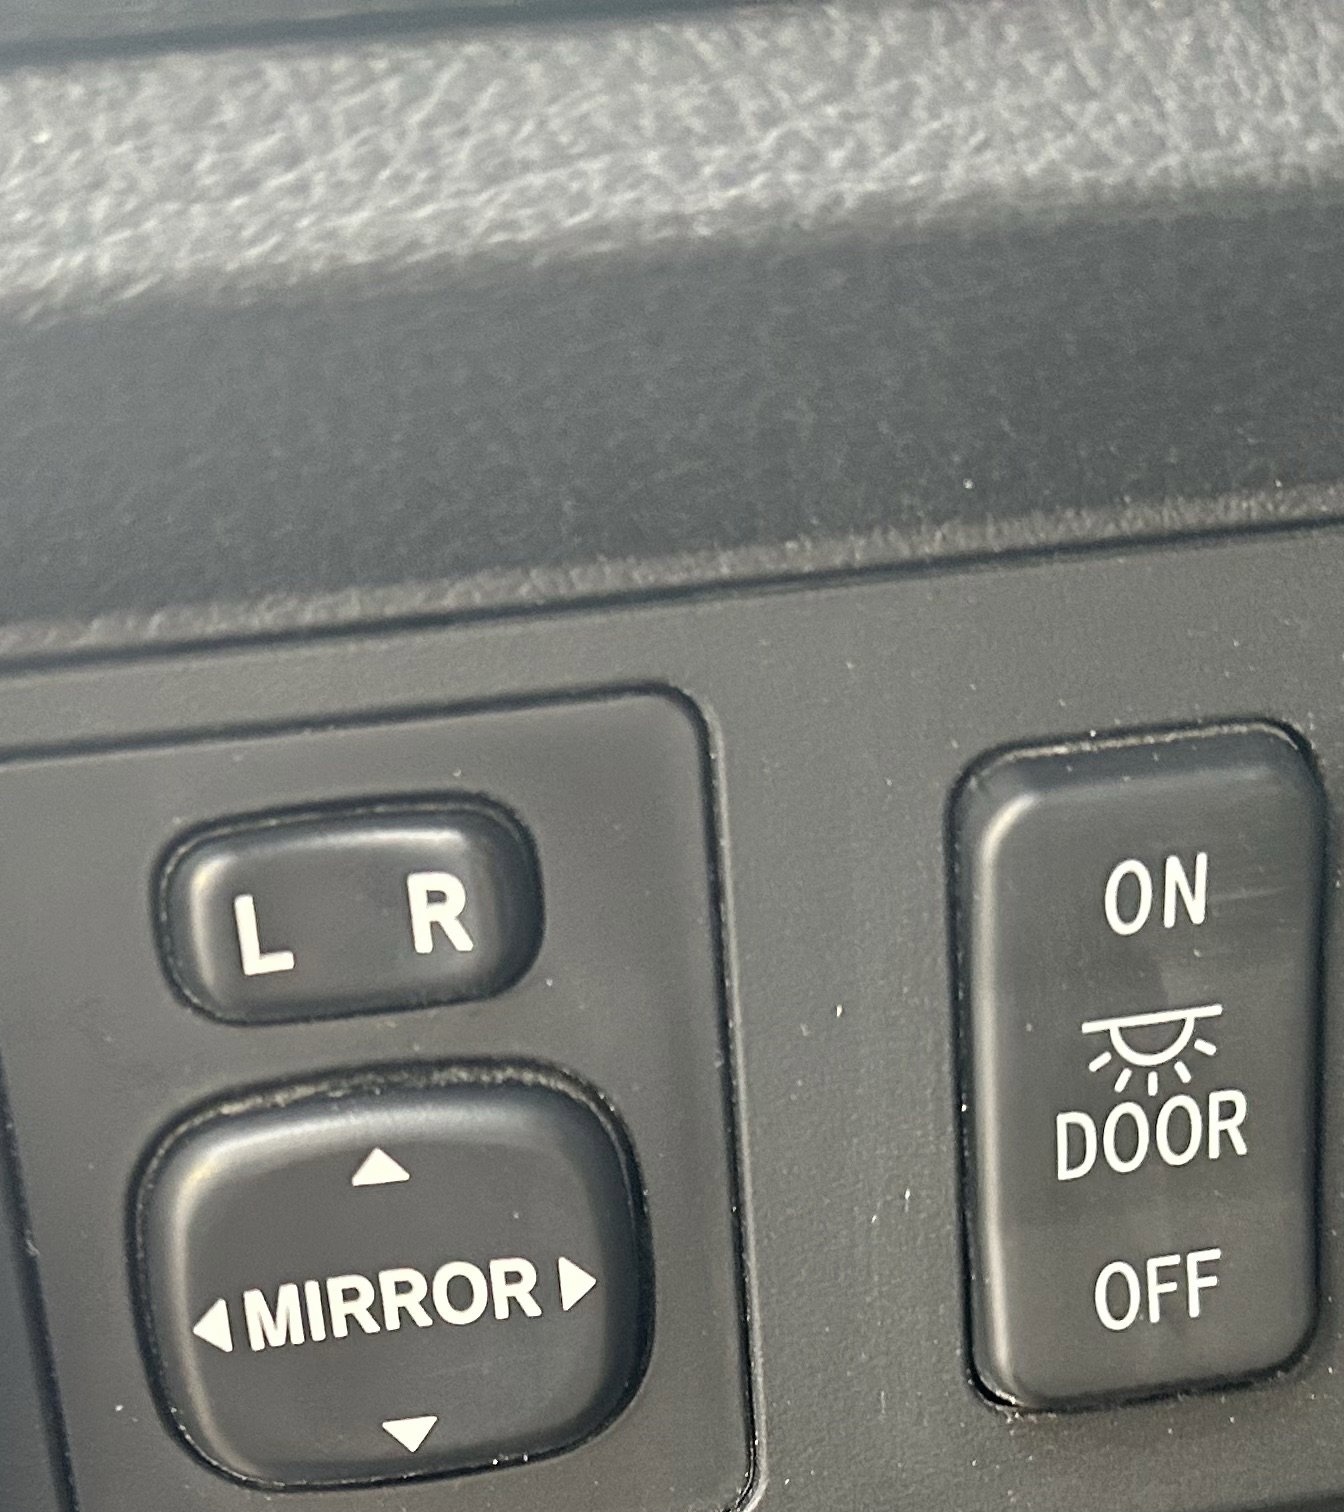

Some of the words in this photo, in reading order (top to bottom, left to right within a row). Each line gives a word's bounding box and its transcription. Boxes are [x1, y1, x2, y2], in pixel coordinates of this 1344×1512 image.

[234, 894, 295, 976] L
[406, 871, 474, 954] R
[1103, 851, 1208, 936] ON
[1056, 1089, 1248, 1181] DOOR
[243, 1257, 542, 1352] MIRROR
[1094, 1248, 1222, 1331] OFF
